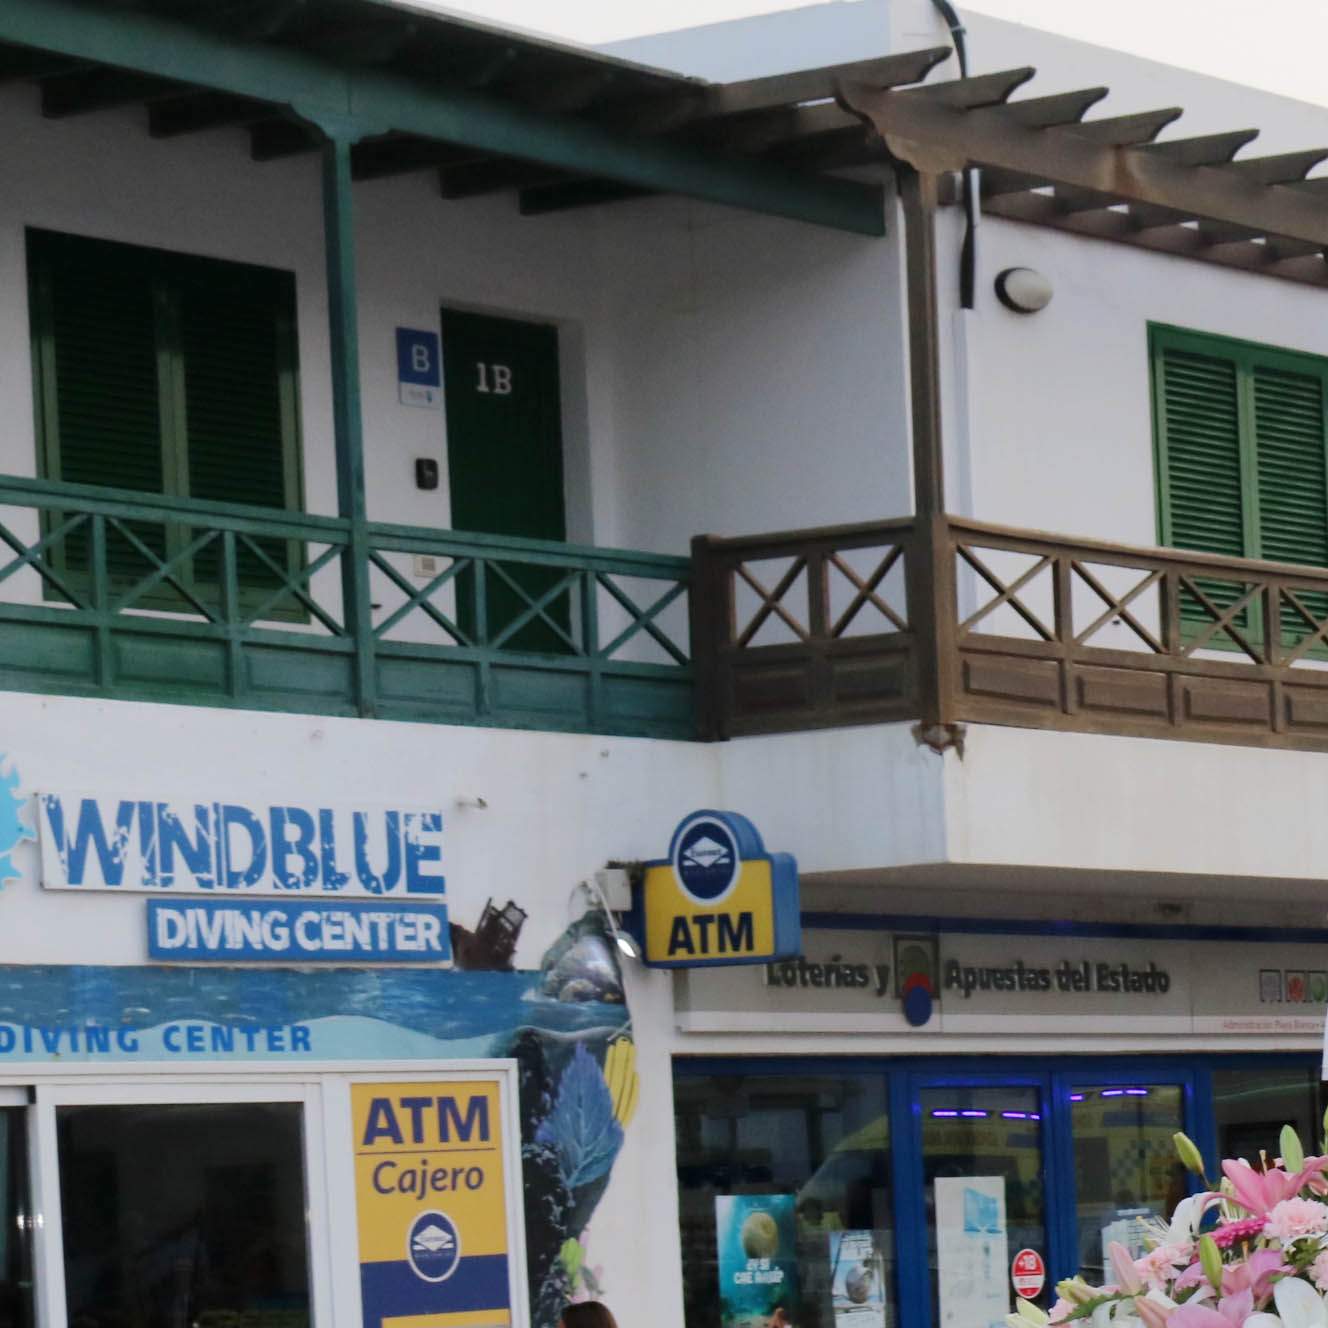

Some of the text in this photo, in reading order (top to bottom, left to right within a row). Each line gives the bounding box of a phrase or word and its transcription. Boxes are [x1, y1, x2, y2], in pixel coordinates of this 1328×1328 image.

[411, 343, 430, 373] B
[476, 361, 512, 395] 1B
[41, 792, 446, 896] WINDBLUE
[156, 907, 443, 953] DIVING CENTER
[667, 911, 755, 956] ATM
[766, 954, 1171, 998] Loterías y Apuestas del Estado
[0, 1023, 313, 1054] DIVING CENTER
[362, 1094, 490, 1146] ATM
[372, 1158, 485, 1201] Cajero
